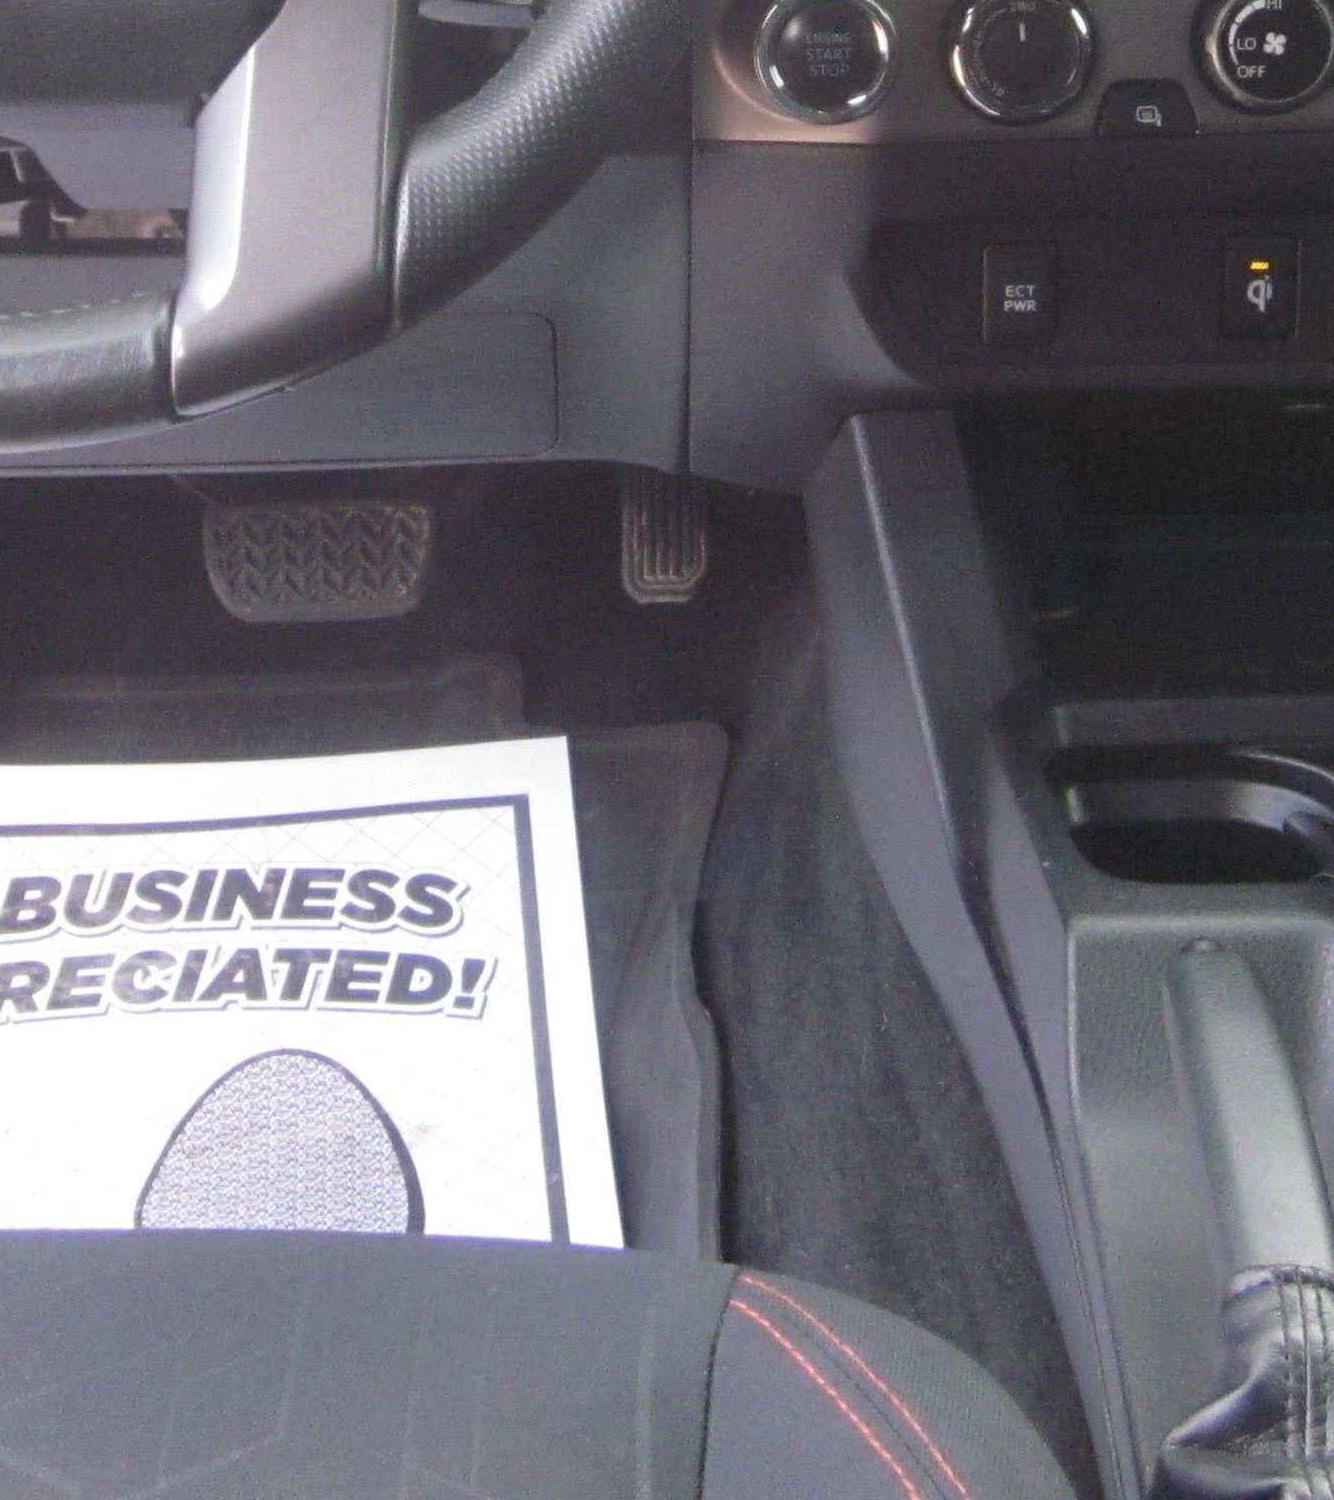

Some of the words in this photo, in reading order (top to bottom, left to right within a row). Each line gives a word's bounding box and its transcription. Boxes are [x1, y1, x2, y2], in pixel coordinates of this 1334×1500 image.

[1237, 38, 1257, 50] LO
[806, 48, 851, 60] START
[810, 64, 849, 76] STOP
[1237, 66, 1266, 78] OFF
[1005, 285, 1036, 298] ECT
[1004, 300, 1036, 312] PWR
